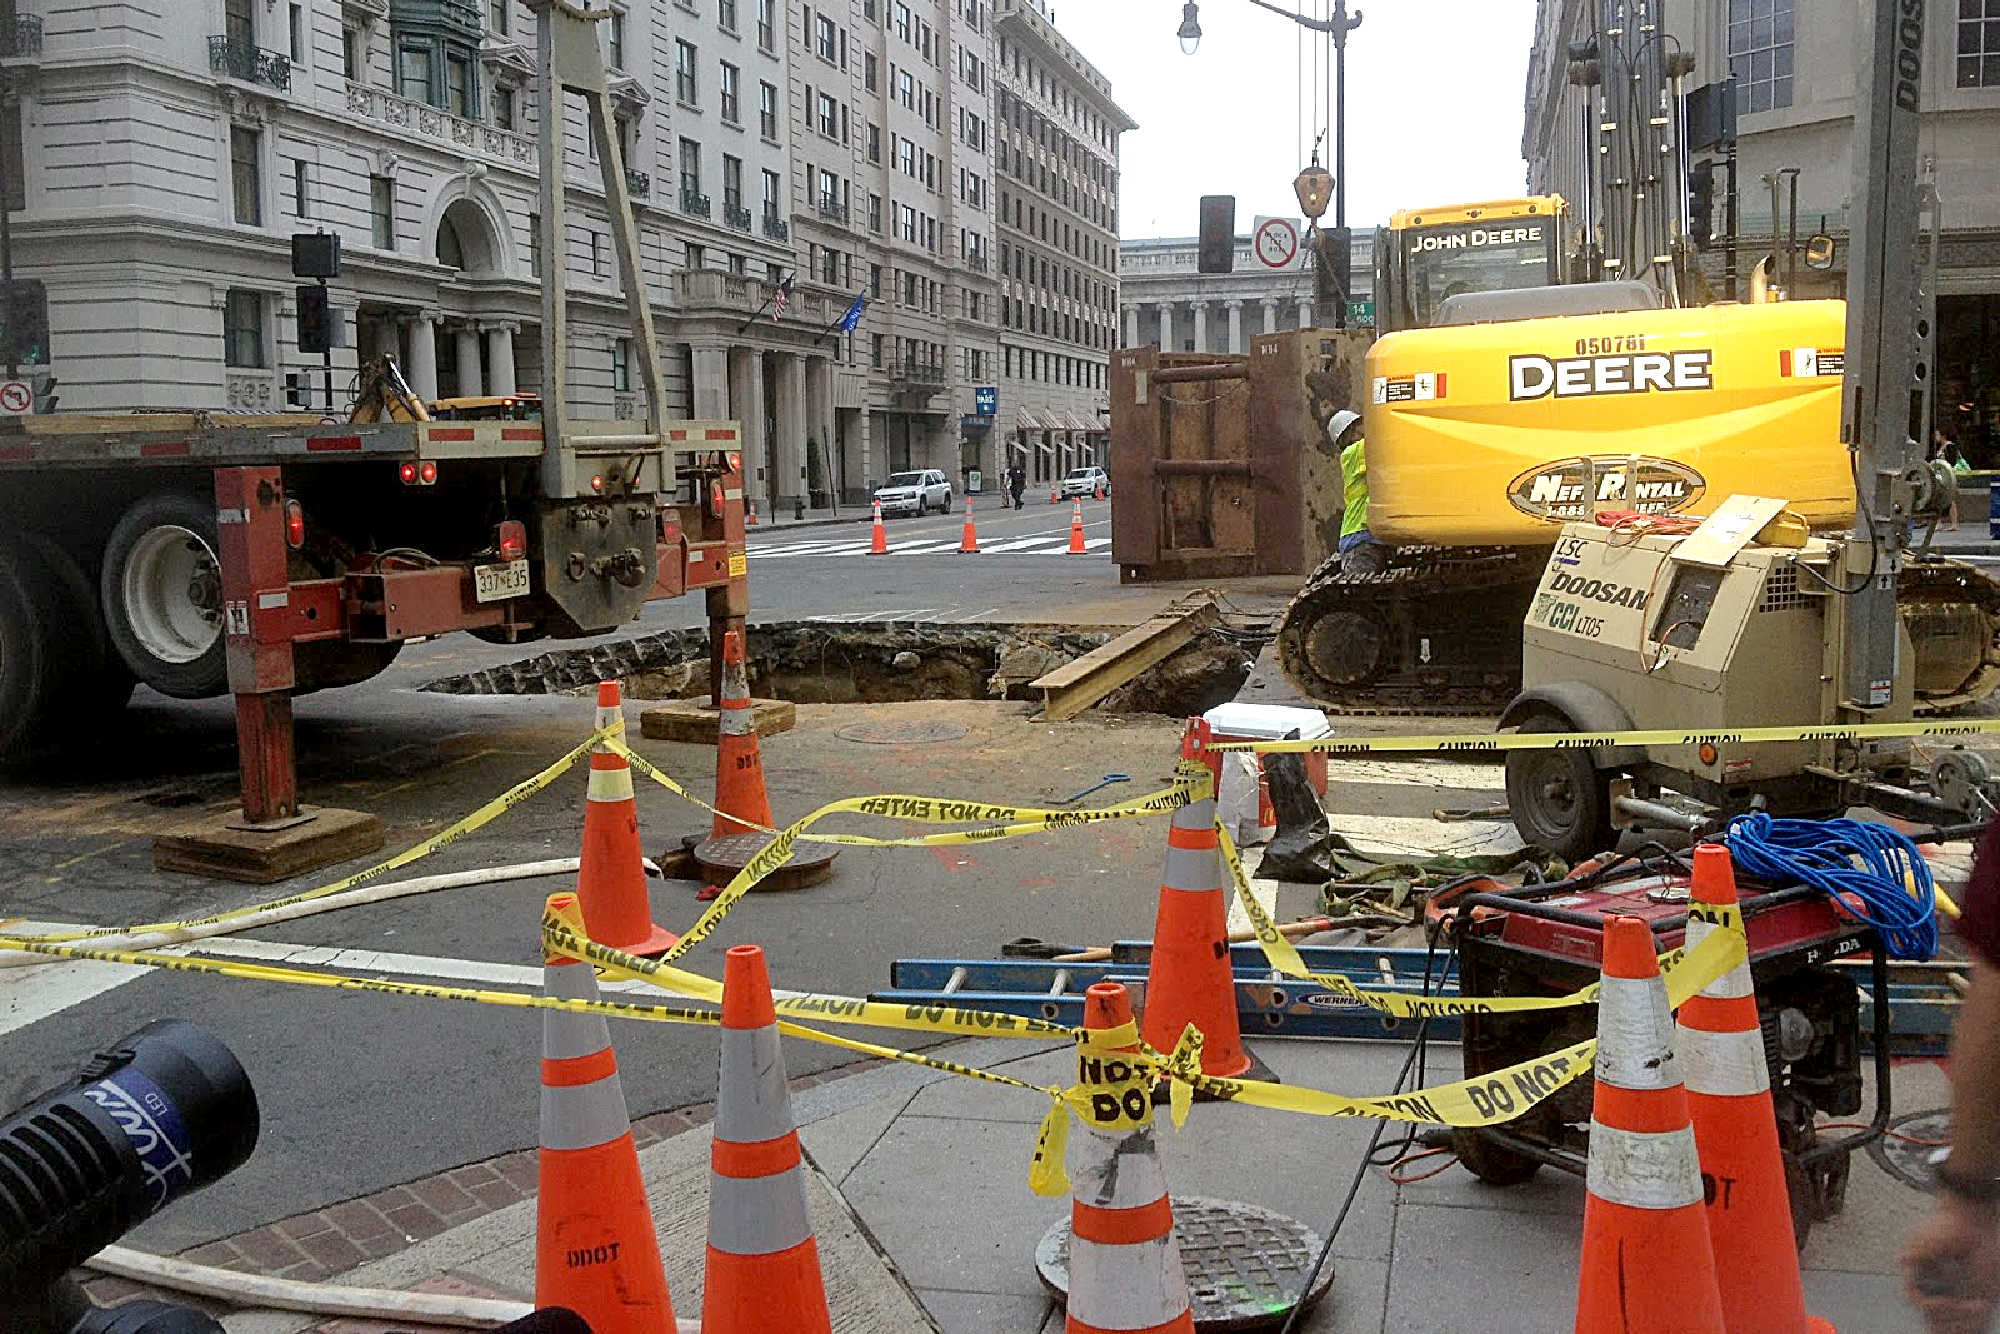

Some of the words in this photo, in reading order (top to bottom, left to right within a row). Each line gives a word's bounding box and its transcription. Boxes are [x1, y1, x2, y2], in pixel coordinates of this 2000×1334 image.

[1410, 233, 1467, 253] JOHN
[1471, 227, 1542, 246] DEERE
[1510, 350, 1712, 401] DEERE
[1530, 474, 1595, 502] NEF
[1597, 473, 1685, 500] RNTAL
[1549, 573, 1651, 611] DOOSAN
[1807, 938, 1861, 964] HDA
[1092, 1087, 1146, 1122] DO
[1465, 1078, 1515, 1119] DO
